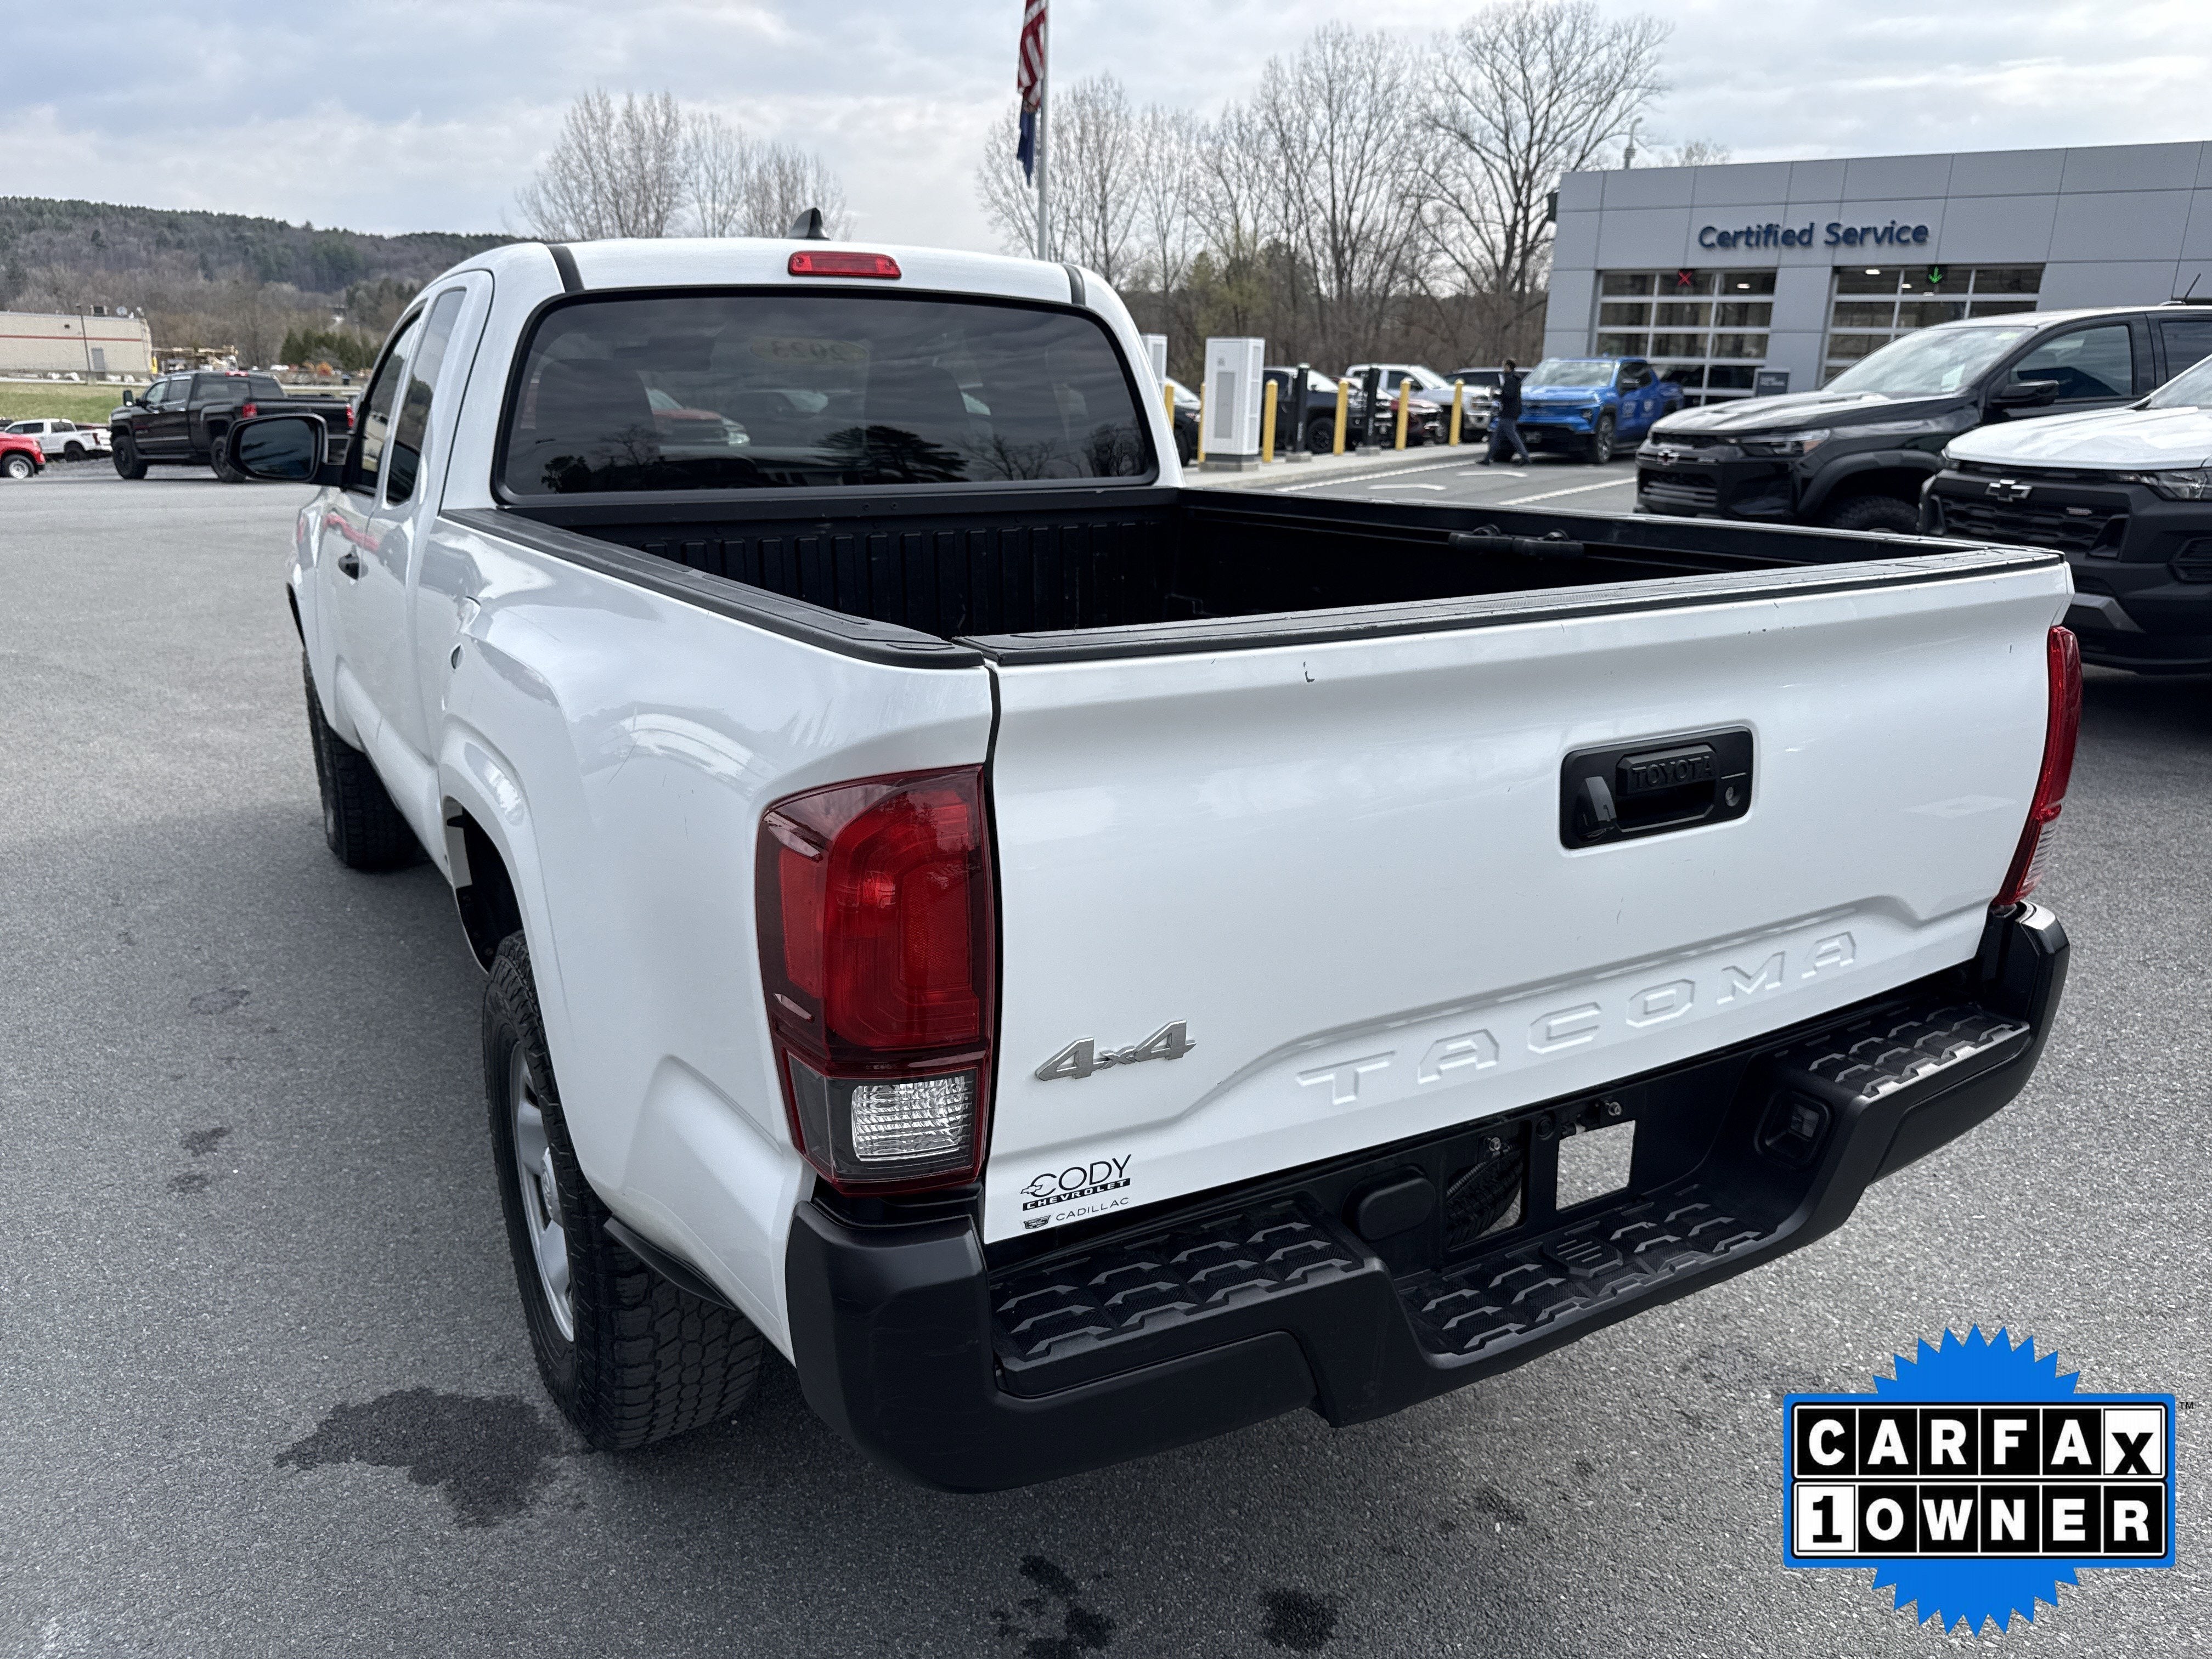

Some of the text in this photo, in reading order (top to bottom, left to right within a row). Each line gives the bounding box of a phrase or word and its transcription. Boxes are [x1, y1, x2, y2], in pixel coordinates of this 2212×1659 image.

[1698, 220, 1929, 249] Certified Service
[1631, 755, 1713, 790] TOYOTA
[1296, 930, 1857, 1105] TACOMA
[1035, 1019, 1198, 1081] 4x4
[1024, 1154, 1132, 1198] CODY
[1025, 1178, 1127, 1210] CHEVROLET
[1056, 1197, 1130, 1221] CADILLAC
